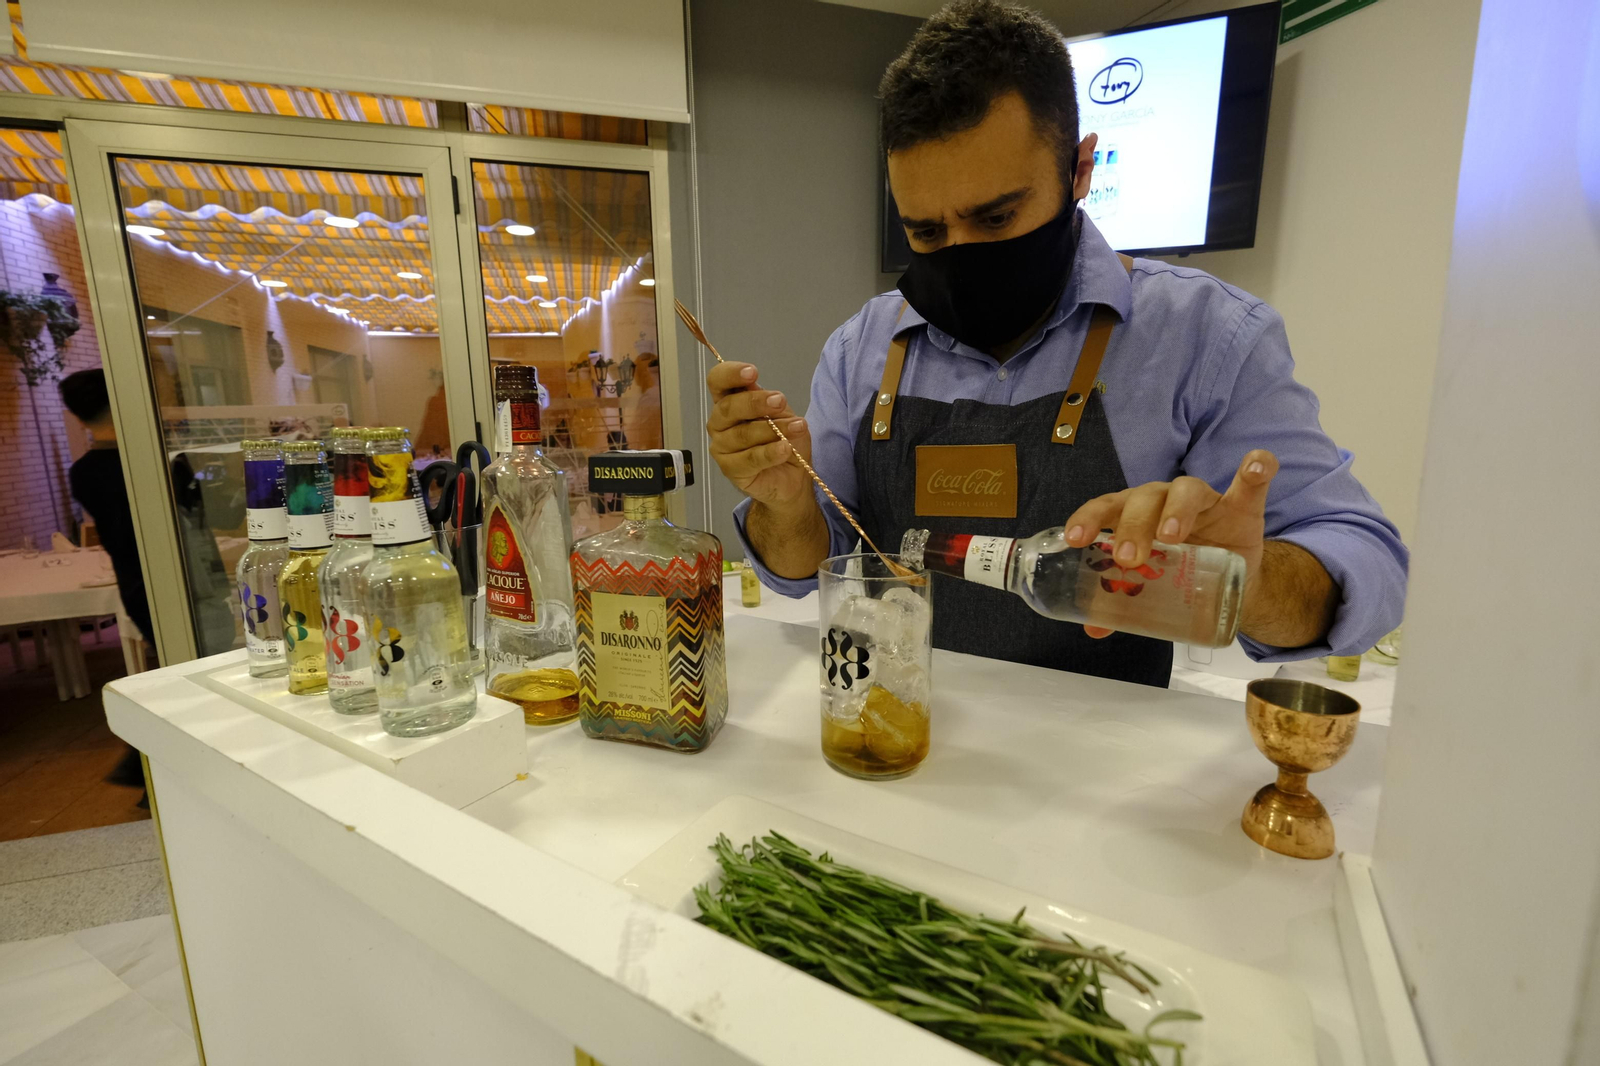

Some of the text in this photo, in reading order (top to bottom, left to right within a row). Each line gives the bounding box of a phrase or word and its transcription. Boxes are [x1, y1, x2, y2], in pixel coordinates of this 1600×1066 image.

[594, 467, 654, 480] DISARONNO
[926, 468, 1006, 495] Coca-Cola
[980, 543, 988, 561] ROYAL
[983, 538, 998, 572] BLISS
[490, 591, 516, 605] AÑEJO
[601, 631, 662, 651] DISARONNO
[611, 650, 652, 660] ORIGINALE
[614, 708, 652, 721] MISSONI
